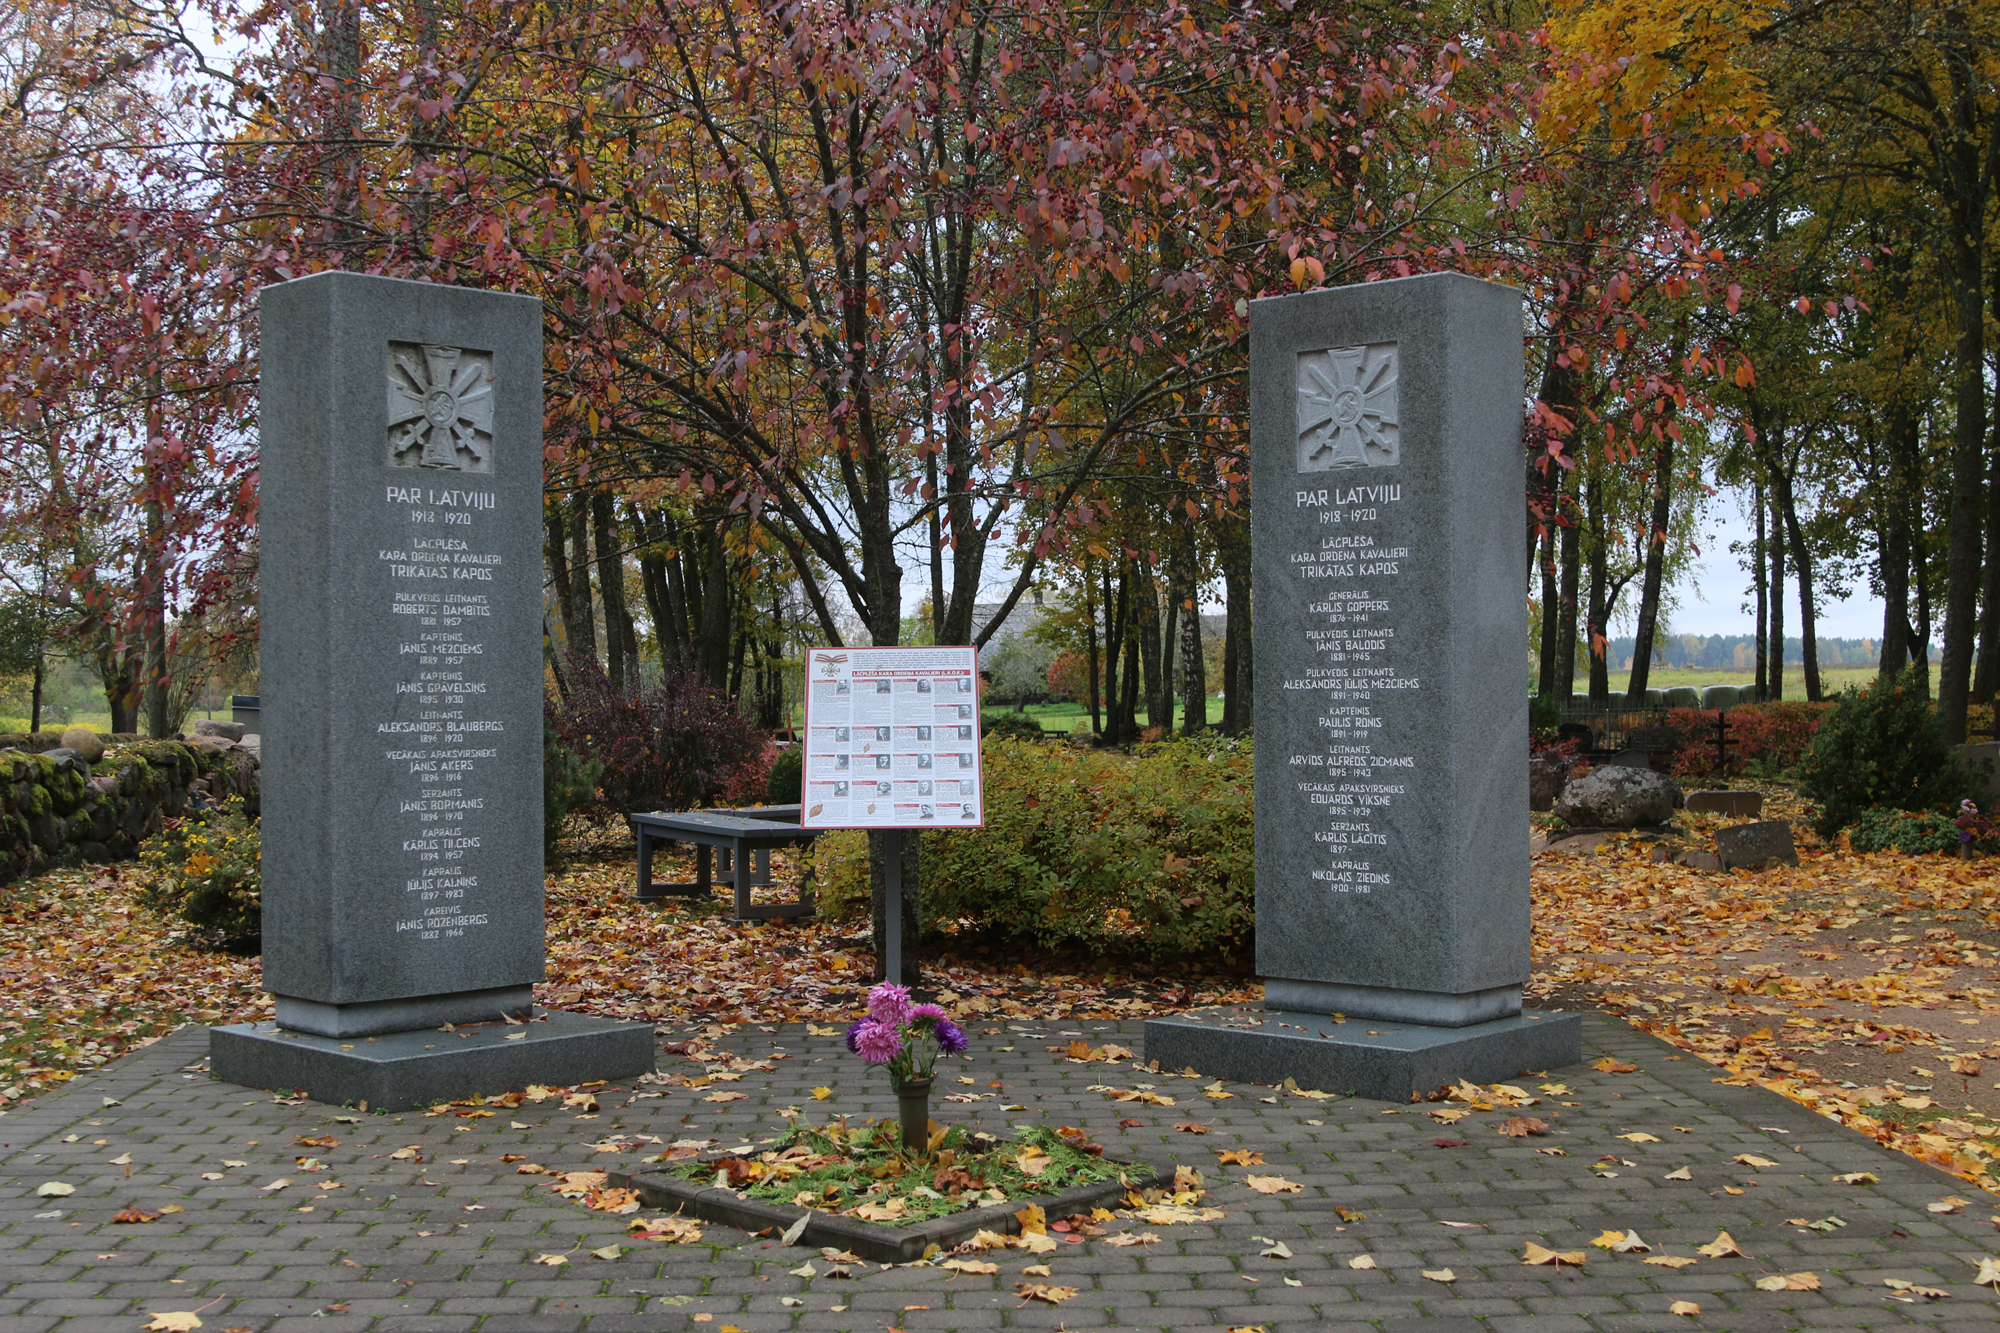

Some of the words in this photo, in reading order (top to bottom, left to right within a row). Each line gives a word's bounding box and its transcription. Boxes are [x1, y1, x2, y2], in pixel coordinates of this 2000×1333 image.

[387, 487, 421, 504] PAR
[429, 490, 495, 510] LATVIJU
[1296, 489, 1328, 507] PAR
[1336, 484, 1400, 504] LATVIJU
[380, 550, 407, 561] KARA
[454, 554, 501, 565] KAVALIERI
[1290, 552, 1316, 563] KARA
[1320, 551, 1356, 562] ORDEŅA
[1360, 548, 1408, 559] KAVALIERI
[453, 568, 492, 580] KAPOS
[1300, 564, 1354, 578] TRIKĀTAS
[1359, 562, 1399, 575] KAPOS
[396, 593, 440, 602] PULKVEDIS
[446, 595, 487, 604] LEITNANTS
[393, 604, 437, 614] ROBERTS
[1309, 602, 1342, 613] KĀRLIS
[1347, 601, 1389, 611] GOPPERS
[421, 633, 462, 641] KAPTEINIS
[1306, 630, 1348, 639] PULKVEDIS
[1352, 629, 1394, 638] LEITNANTS
[400, 643, 426, 655] JĀNIS
[1316, 640, 1341, 652] JĀNIS
[1346, 640, 1385, 650] BALODIS
[421, 672, 462, 680] KAPTEINIS
[1306, 669, 1348, 677] PULKVEDIS
[1352, 668, 1394, 676] LEITNANTS
[397, 682, 423, 694] JĀNIS
[1283, 679, 1341, 690] ALEKSANDRS
[1344, 678, 1368, 690] JŪLIJS
[1329, 707, 1370, 715] KAPTEINIS
[378, 722, 442, 733] ALEKSANDRS
[447, 721, 504, 731] BLAUBERGS
[1319, 718, 1350, 727] PAULIS
[1356, 718, 1382, 728] RONIS
[386, 750, 426, 759] VECĀKAIS
[410, 761, 436, 773] JĀNIS
[1289, 755, 1323, 766] ARVĪDS
[1327, 755, 1366, 766] ALFRĒDS
[1371, 757, 1414, 767] ZICMANIS
[1298, 783, 1335, 792] VECĀKAIS
[400, 801, 427, 812] JĀNIS
[431, 799, 483, 810] BORMANIS
[1311, 794, 1353, 804] EDUARDS
[1358, 795, 1390, 805] VĪKSNE
[403, 839, 438, 850] KĀRLIS
[443, 838, 480, 848] TILCENS
[1315, 832, 1347, 842] KĀRLIS
[1352, 833, 1386, 844] LĀCĪTIS
[1332, 861, 1369, 870] KAPRĀLIS
[1312, 871, 1352, 883] NIKOLAJS
[407, 879, 433, 891] JŪLIJS
[424, 906, 461, 916] KAREIVIS
[397, 918, 423, 932] JĀNIS
[427, 914, 488, 928] ROZENBERGS
